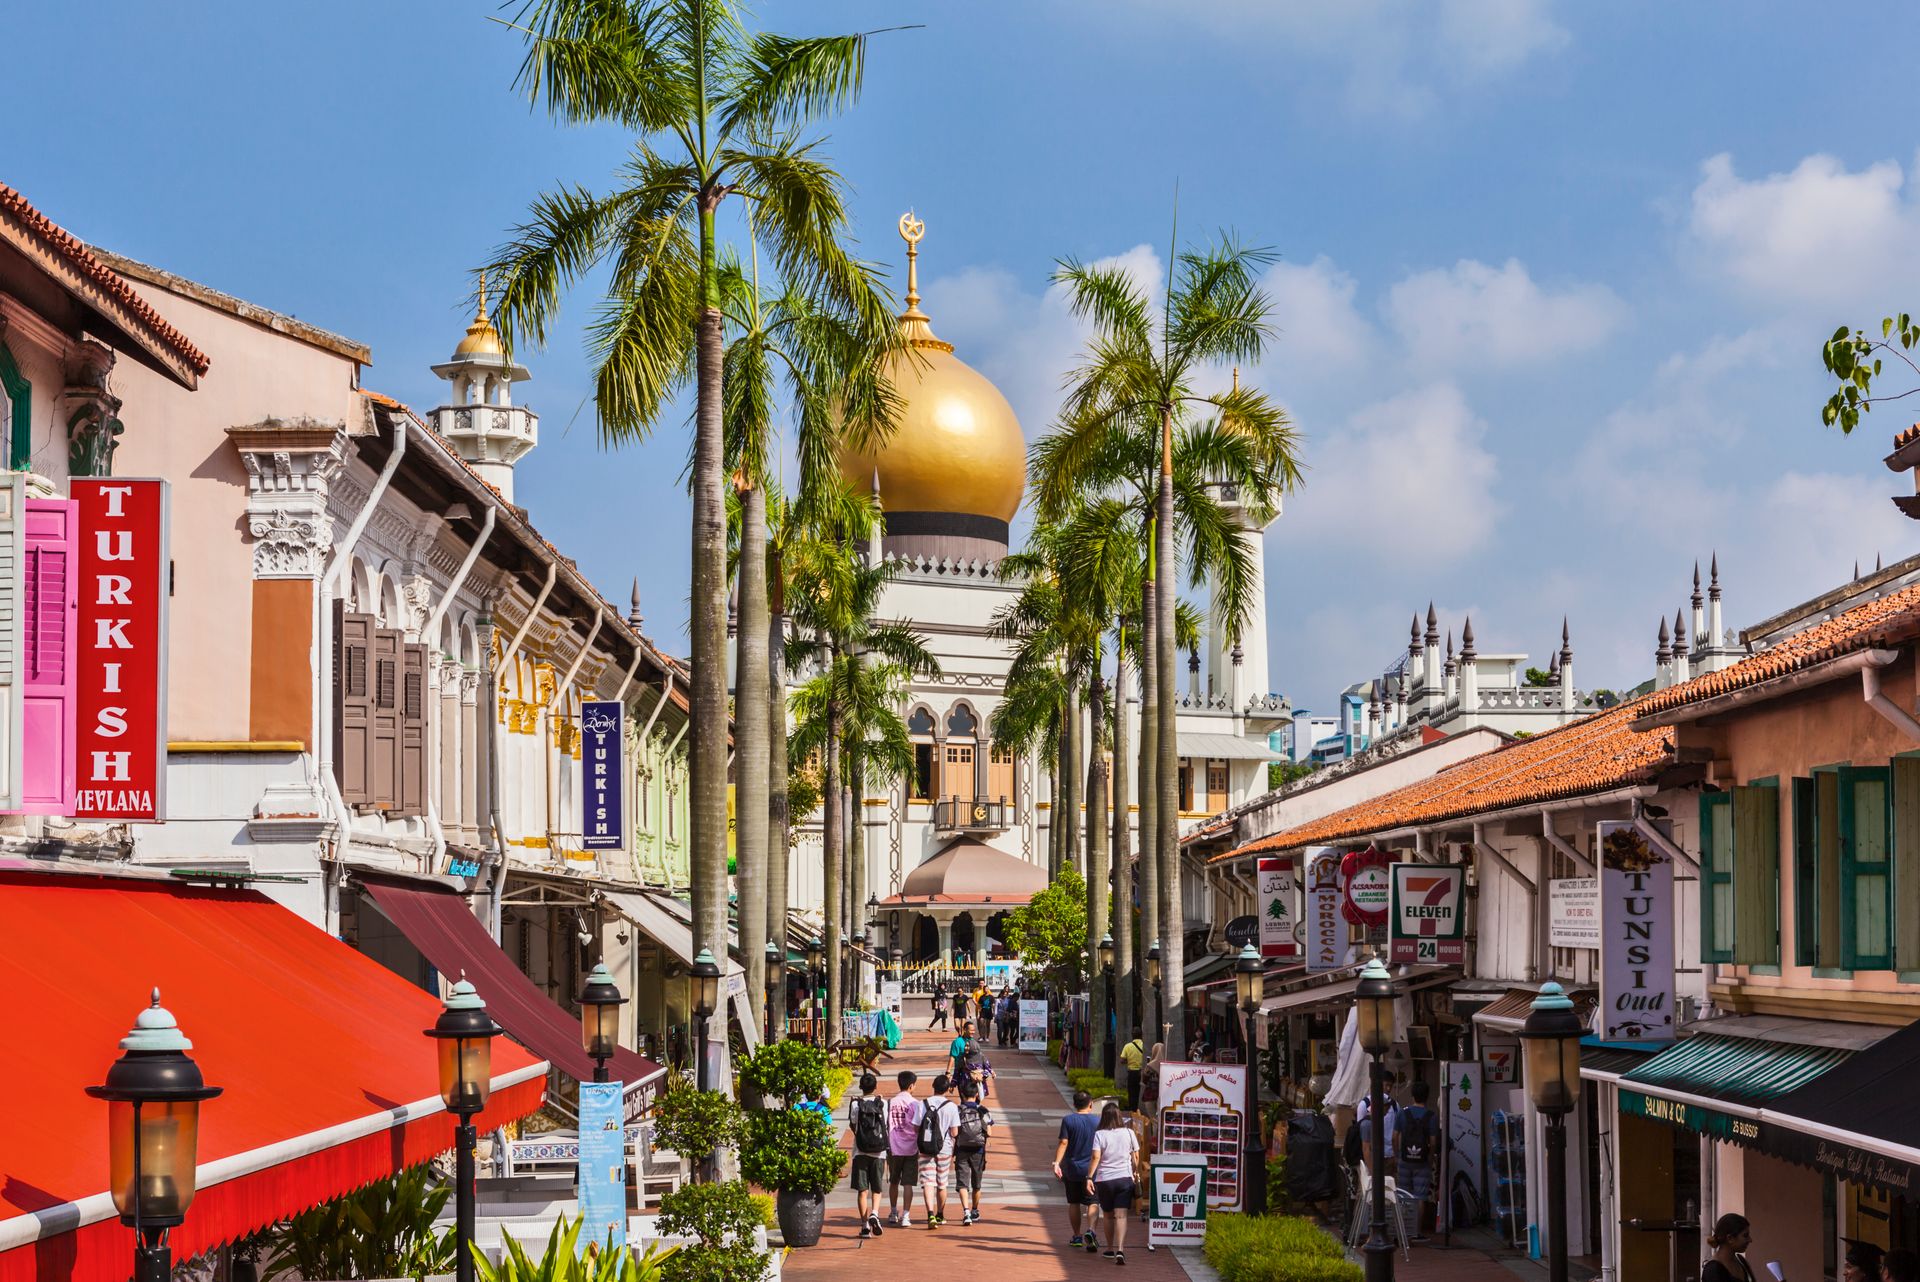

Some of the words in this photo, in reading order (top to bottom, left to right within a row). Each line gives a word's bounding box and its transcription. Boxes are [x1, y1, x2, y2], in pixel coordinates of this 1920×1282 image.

[595, 734, 607, 834] TURKISH
[1263, 881, 1290, 894] لبنان
[1319, 895, 1336, 963] MOROCCAN
[1623, 873, 1654, 988] TUNSI
[1419, 942, 1436, 958] 24
[1440, 945, 1460, 953] HOURS
[1616, 992, 1665, 1011] Oud
[1645, 1096, 1668, 1119] SALMIN
[1669, 1102, 1674, 1120] &
[1732, 1120, 1739, 1133] 25
[1153, 1221, 1168, 1229] OPEN
[1171, 1220, 1184, 1232] 24
[1185, 1222, 1206, 1230] HOURS
